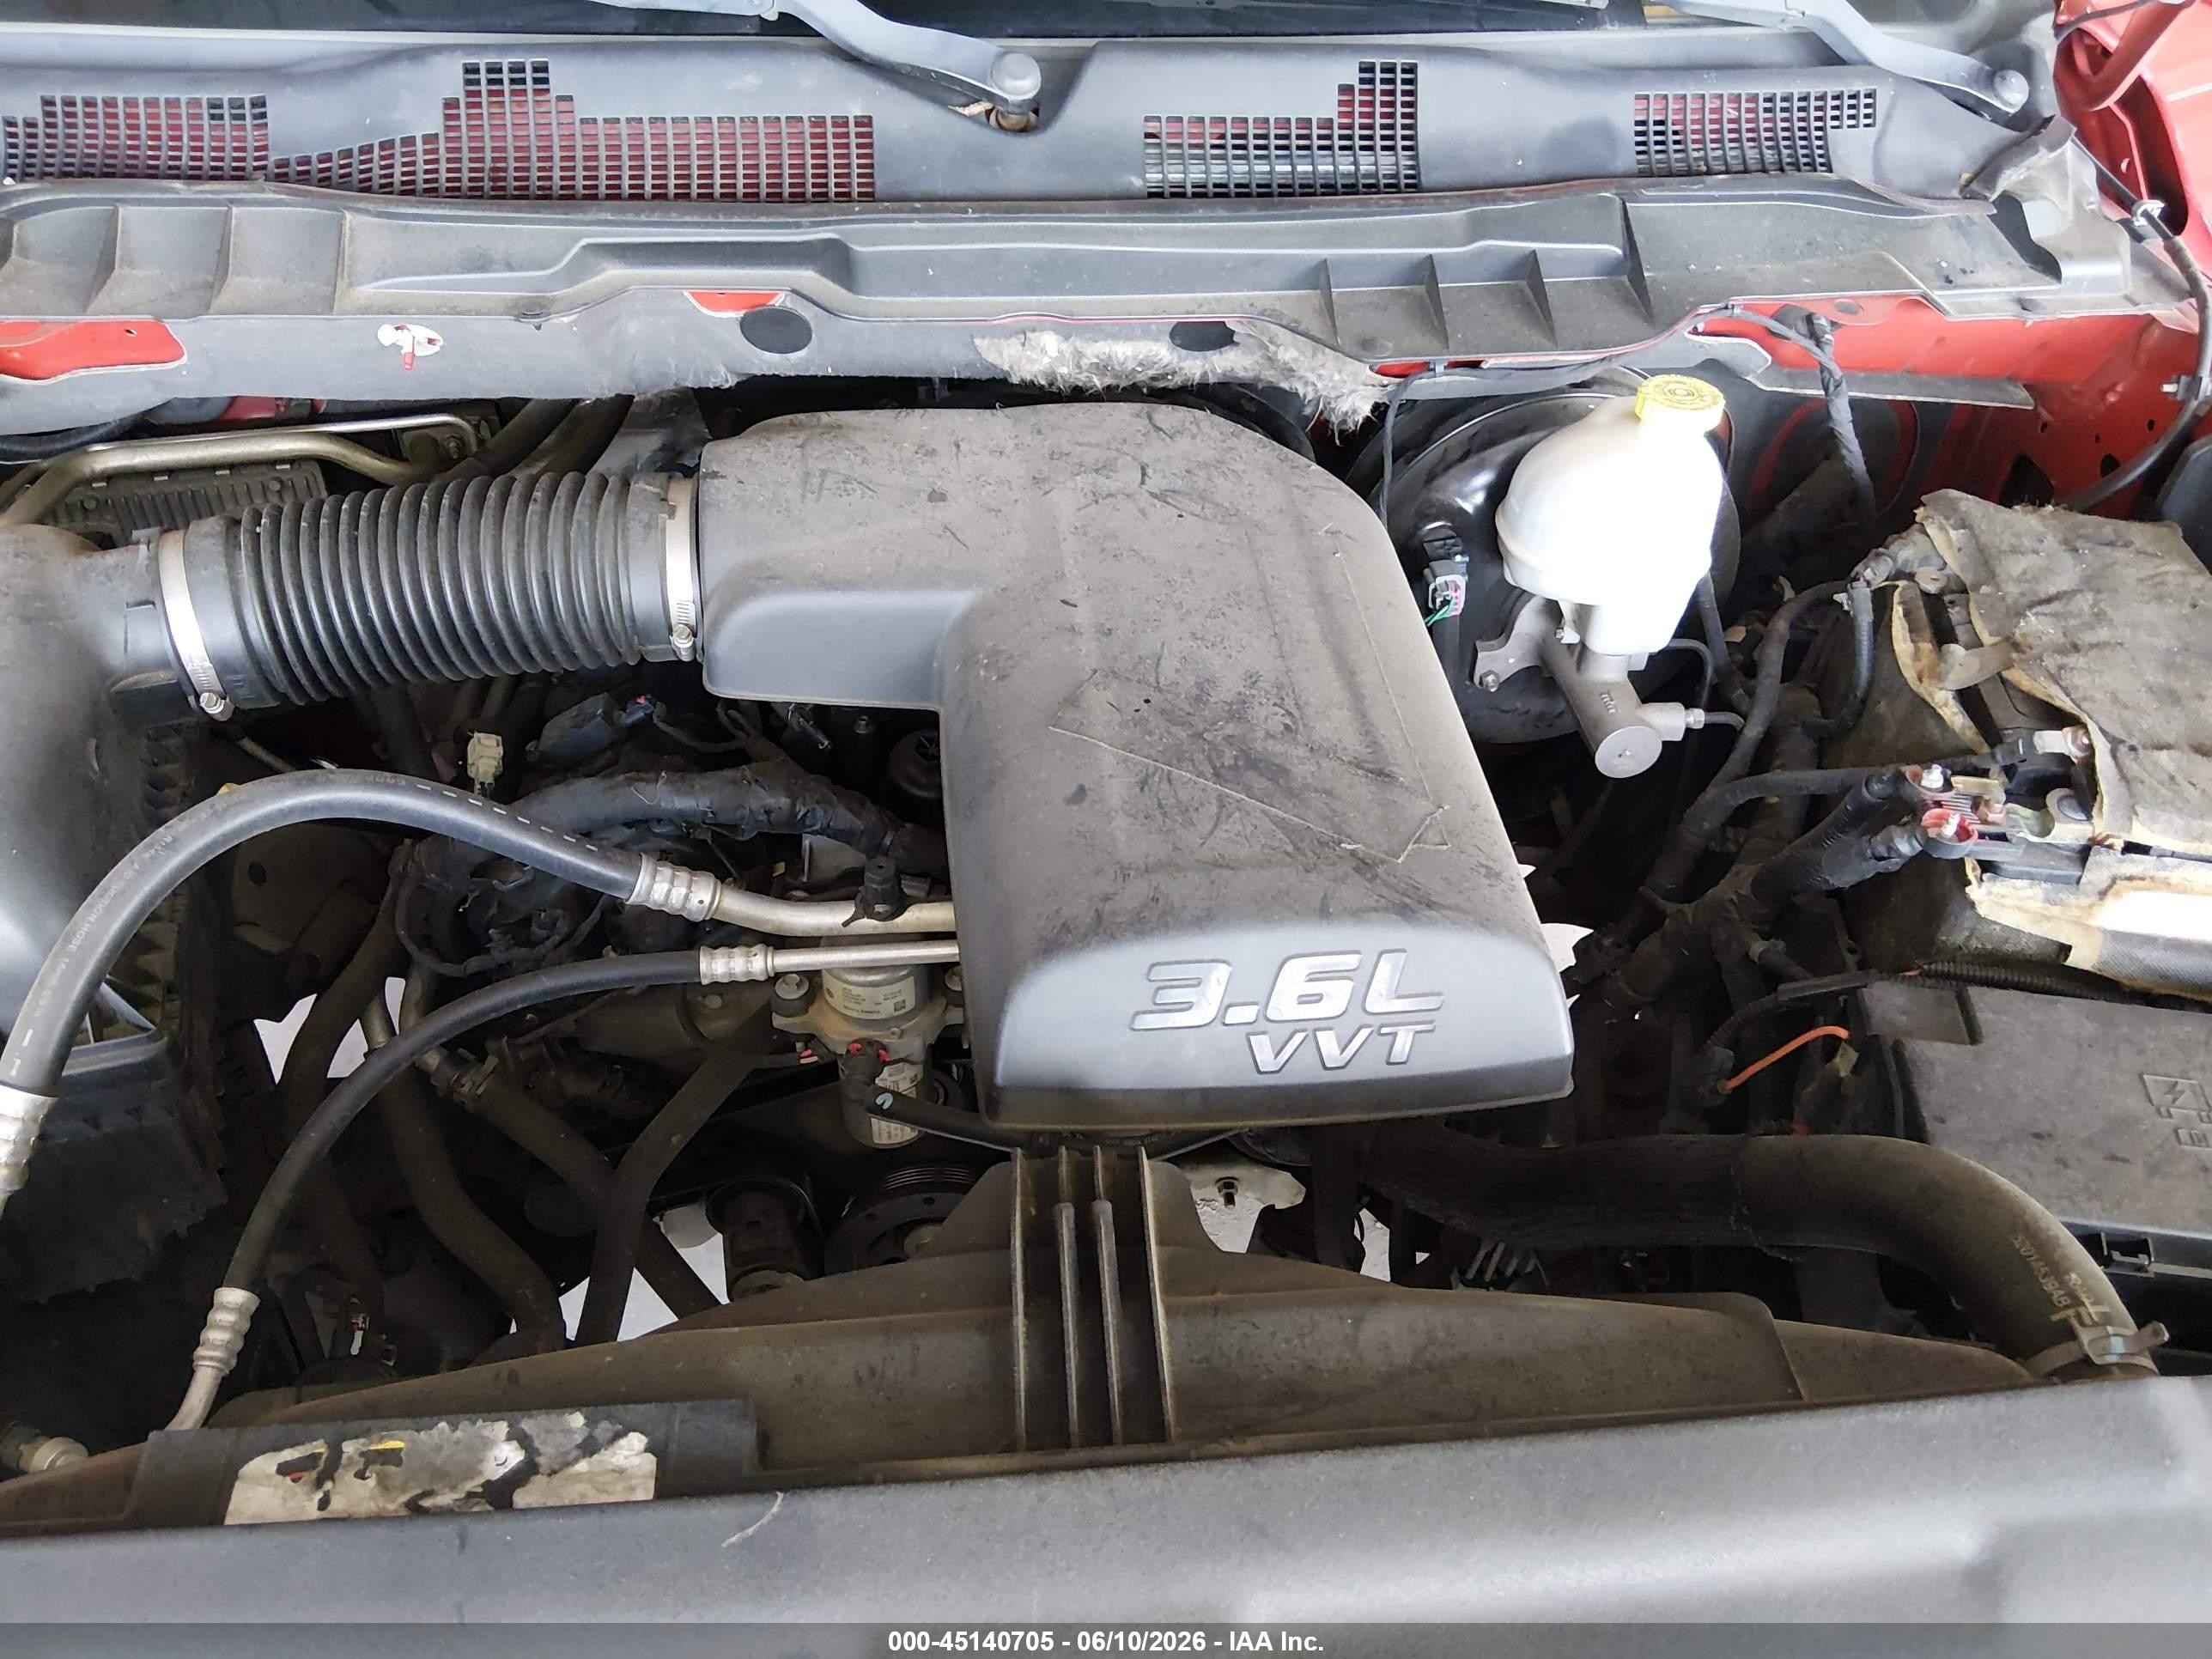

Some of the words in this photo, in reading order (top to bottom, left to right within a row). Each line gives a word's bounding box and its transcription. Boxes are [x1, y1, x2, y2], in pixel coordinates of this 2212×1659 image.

[68, 922, 93, 953] HOSE
[1129, 948, 1444, 1031] 3.6L
[1247, 1018, 1437, 1074] VVT
